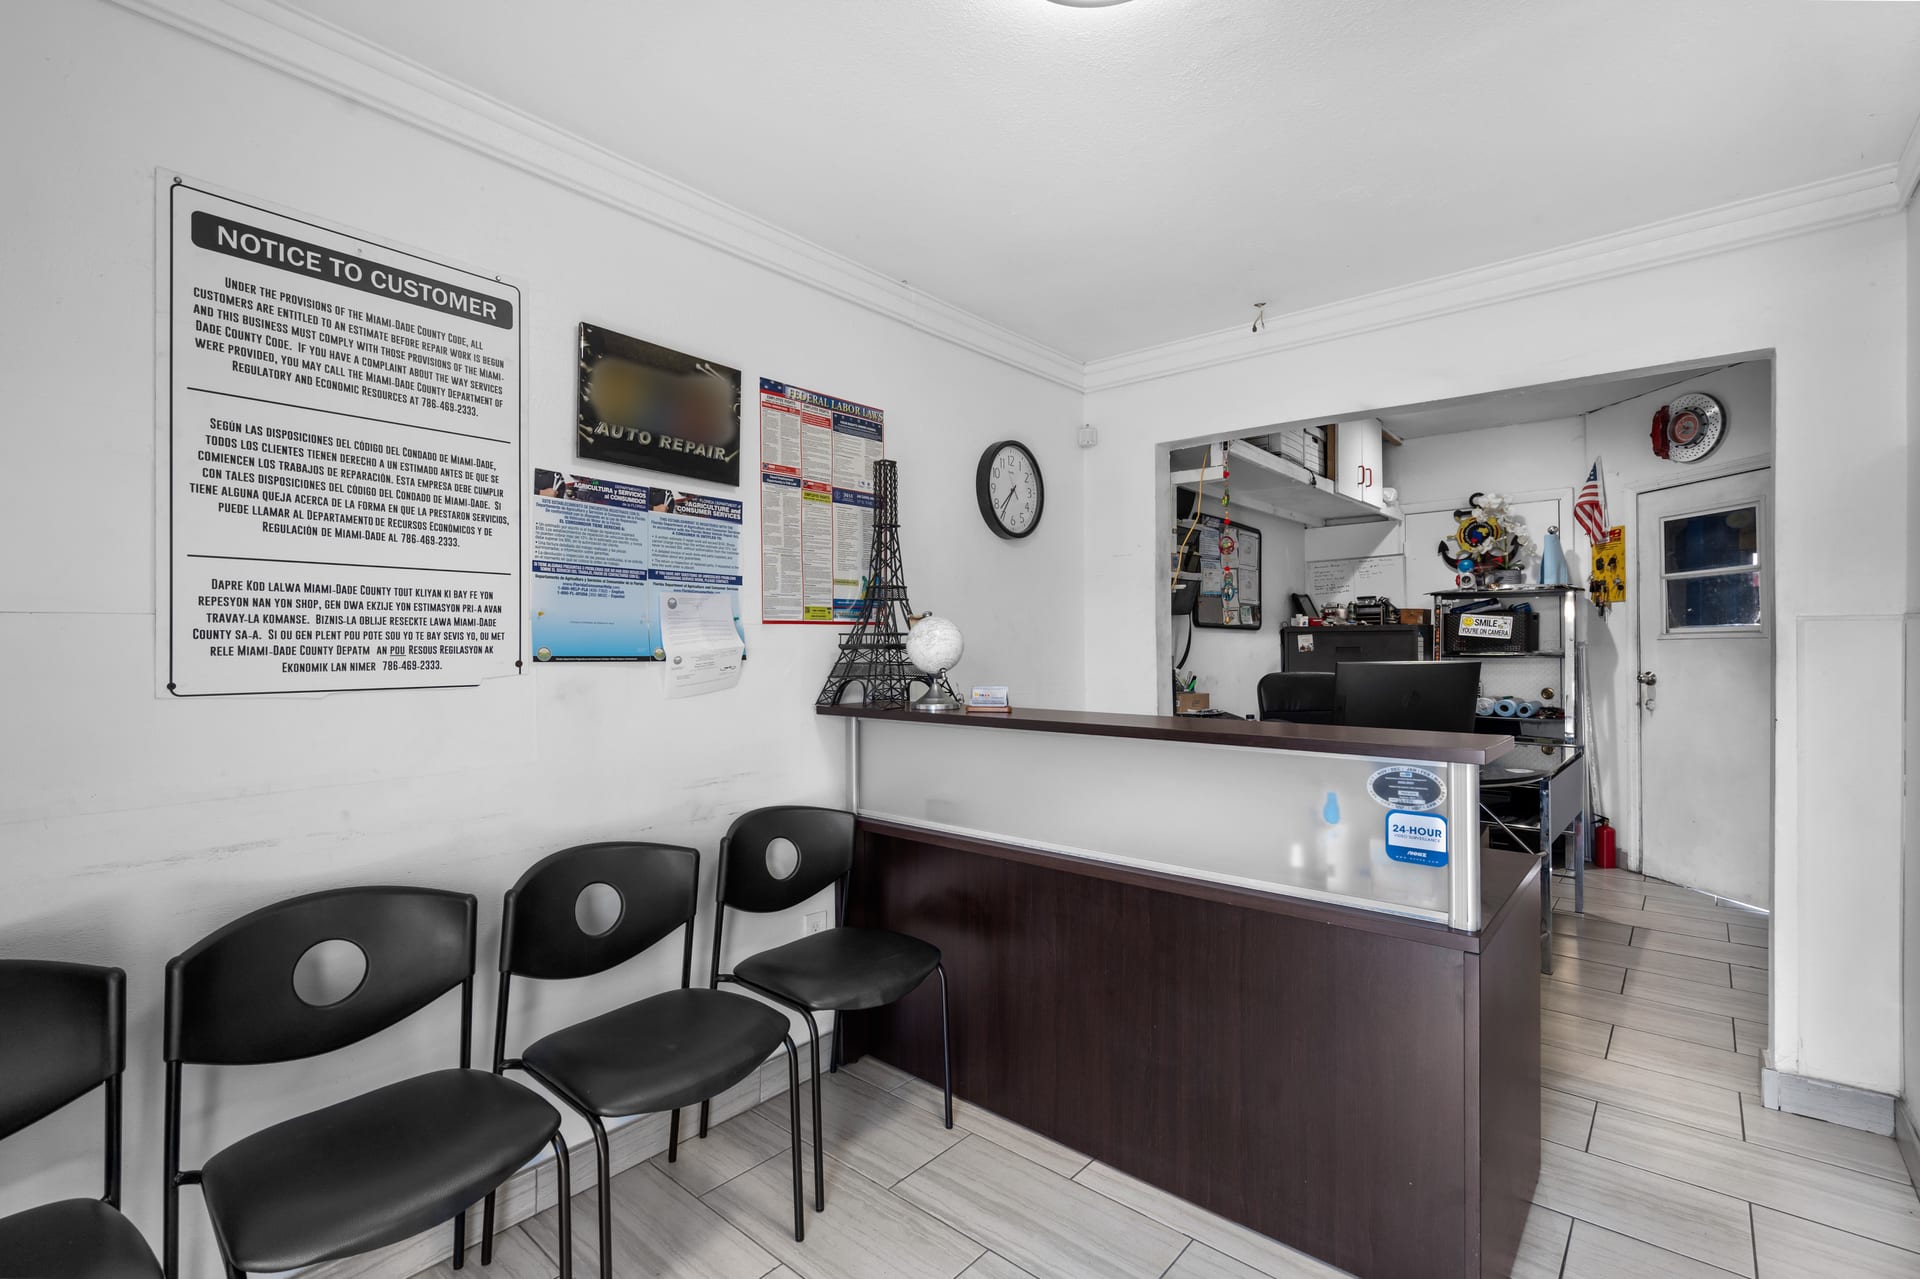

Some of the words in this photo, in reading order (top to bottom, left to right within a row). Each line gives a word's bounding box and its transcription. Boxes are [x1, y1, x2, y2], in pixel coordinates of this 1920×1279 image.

[218, 224, 323, 272] NOTICE
[329, 257, 363, 282] TO
[371, 270, 497, 320] CUSTOMER
[225, 276, 256, 295] UNDER
[259, 286, 277, 300] THE
[279, 291, 332, 313] PROVISIONS
[334, 305, 345, 316] OF
[347, 308, 363, 321] THE
[365, 312, 415, 333] MIAMI-DADE
[417, 325, 445, 340] COUNTY
[470, 339, 483, 350] ALL
[193, 286, 253, 310] CUSTOMERS
[256, 302, 274, 315] ARE
[277, 306, 318, 325] ENTITLED
[321, 317, 332, 328] TO
[334, 320, 345, 331] AN
[348, 324, 388, 342] ESTIMATE
[391, 334, 419, 349] BEFORE
[421, 341, 447, 355] REPAIR
[449, 348, 471, 360] WORK
[473, 354, 480, 362] IS
[482, 356, 504, 368] BEGUN
[193, 303, 214, 317] AND
[216, 308, 239, 323] THIS
[242, 314, 288, 334] BUSINESS
[291, 326, 316, 340] MUST
[319, 332, 353, 348] COMPLY
[356, 340, 378, 354] WITH
[381, 346, 405, 360] THOSE
[407, 352, 451, 370] PROVISIONS
[453, 362, 462, 372] OF
[464, 365, 477, 376] THE
[195, 319, 221, 336] DADE
[224, 326, 262, 344] COUNTY
[298, 342, 306, 353] IF
[309, 345, 326, 358] YOU
[329, 349, 351, 363] HAVE
[353, 355, 359, 364] A
[361, 356, 406, 374] COMPLAINT
[409, 367, 433, 380] ABOUT
[435, 372, 448, 383] THE
[450, 376, 468, 387] WAY
[470, 380, 502, 394] SERVICES
[194, 337, 224, 352] WERE
[280, 355, 298, 367] YOU
[302, 359, 322, 372] MAY
[324, 364, 345, 377] CALL
[348, 368, 363, 380] THE
[366, 371, 414, 390] MIAMI-DADE
[417, 382, 445, 396] COUNTY
[448, 388, 492, 406] DEPARTMENT
[494, 398, 503, 408] OF
[232, 360, 292, 381] REGULATORY
[294, 373, 312, 385] AND
[315, 376, 359, 394] ECONOMIC
[361, 385, 407, 403] RESOURCES
[409, 396, 419, 405] AT
[421, 396, 478, 416] 786-469-2333.
[789, 389, 828, 407] FEDERAL
[831, 399, 861, 416] LABOR
[862, 408, 884, 422] LAWS
[245, 424, 263, 436] LAS
[266, 427, 333, 446] DISPOSICIONES
[336, 438, 351, 449] DEL
[385, 445, 400, 456] DEL
[402, 446, 437, 461] CONDADO
[439, 453, 448, 463] DE
[596, 422, 652, 445] AUTO
[659, 434, 727, 461] REPAIR
[205, 434, 237, 448] TODOS
[240, 439, 258, 451] LOS
[261, 442, 304, 457] CLIENTES
[307, 448, 337, 462] TIENEN
[340, 453, 376, 467] DERECHO
[379, 459, 384, 468] A
[387, 460, 397, 470] UN
[400, 462, 438, 475] ESTIMADO
[440, 468, 462, 479] ANTES
[465, 471, 473, 480] DE
[475, 472, 488, 482] QUE
[490, 474, 499, 483] SE
[1000, 458, 1005, 469] 11
[1008, 455, 1014, 466] 12
[993, 467, 1000, 478] 10
[1024, 472, 1029, 483] 2
[574, 483, 612, 493] AGRICULTURA
[618, 490, 646, 498] SERVICIOS
[991, 483, 996, 493] 9
[1027, 488, 1031, 498] 3
[689, 502, 729, 512] AGRICULTURE
[994, 498, 999, 509] 8
[1025, 502, 1029, 512] 4
[677, 506, 711, 515] CONSUMER
[713, 511, 740, 520] SERVICES
[1020, 513, 1024, 523] 5
[1011, 515, 1015, 526] 6
[321, 527, 332, 537] DE
[334, 527, 385, 541] MIAMI-DADE
[388, 533, 398, 542] AL
[401, 533, 460, 547] 786-469-2333.
[211, 578, 243, 590] DAPRE
[246, 579, 265, 591] KOD
[268, 582, 301, 592] LALWA
[303, 582, 357, 595] MIAMI-DADE
[360, 584, 391, 596] COUNTY
[394, 587, 412, 596] TOUT
[415, 588, 442, 598] KLIYAN
[444, 589, 451, 598] KI
[453, 590, 467, 598] BAY
[469, 590, 477, 599] FE
[479, 591, 493, 600] YON
[1475, 619, 1497, 627] SMILE
[282, 662, 328, 672] EKONOMIK
[331, 662, 346, 672] LAN
[350, 662, 376, 671] NIMER
[382, 660, 442, 670] 786-469-2333.
[1393, 824, 1442, 838] 24-HOUR
